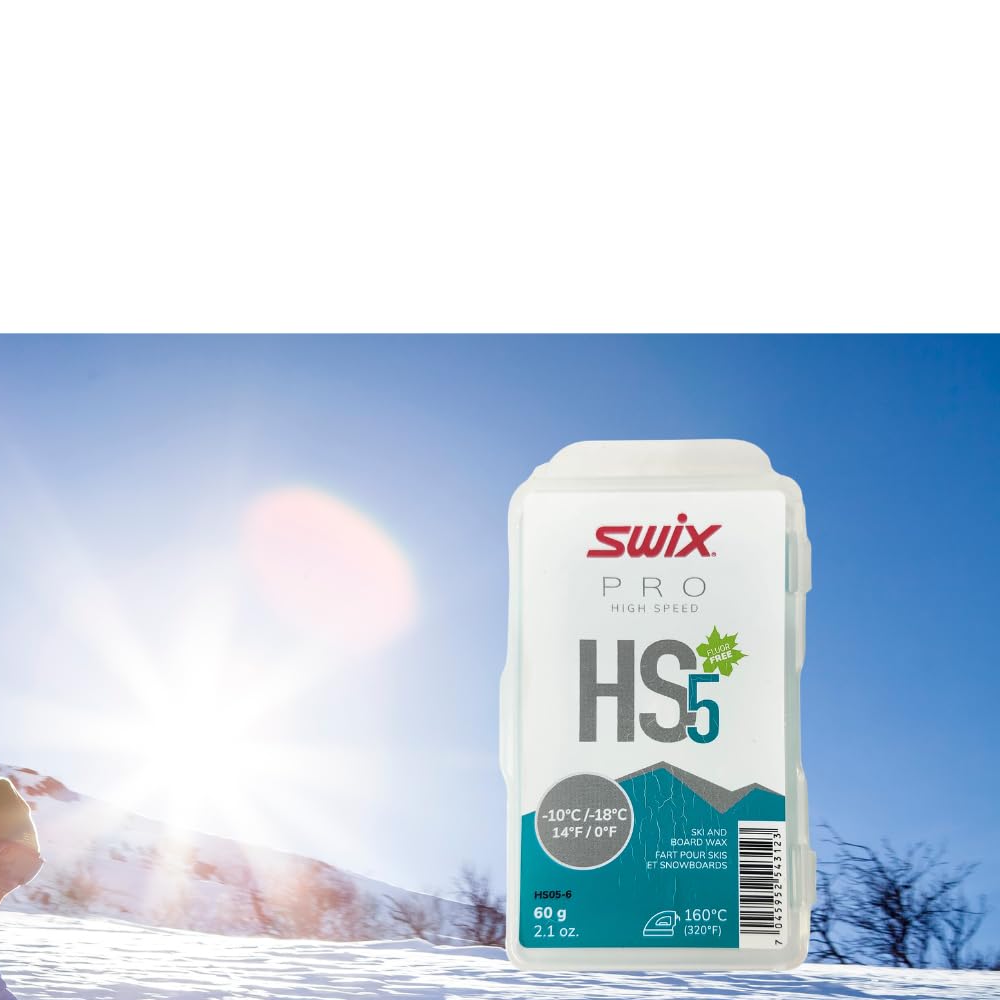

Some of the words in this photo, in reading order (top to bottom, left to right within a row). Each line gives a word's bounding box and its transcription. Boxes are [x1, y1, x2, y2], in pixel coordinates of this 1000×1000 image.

[602, 576, 706, 597] PRO
[611, 603, 646, 613] HIGH
[654, 603, 699, 613] SPEED
[707, 643, 731, 657] FLUOR
[710, 650, 733, 664] FREE
[691, 828, 705, 836] SKI
[707, 828, 727, 836] AND
[670, 838, 703, 846] BOARD
[706, 838, 727, 846] WAX
[655, 851, 677, 859] FART
[680, 851, 705, 859] POUR
[708, 851, 727, 859] SKIS
[647, 861, 657, 869] ET
[660, 861, 727, 869] SNOWBOARDS
[534, 890, 572, 899] HS05-6
[533, 906, 553, 919] 60
[556, 909, 567, 922] g
[685, 908, 727, 922] 160°C
[533, 925, 555, 938] 2.1
[559, 927, 579, 938] oz.
[684, 925, 722, 937] (320°F)
